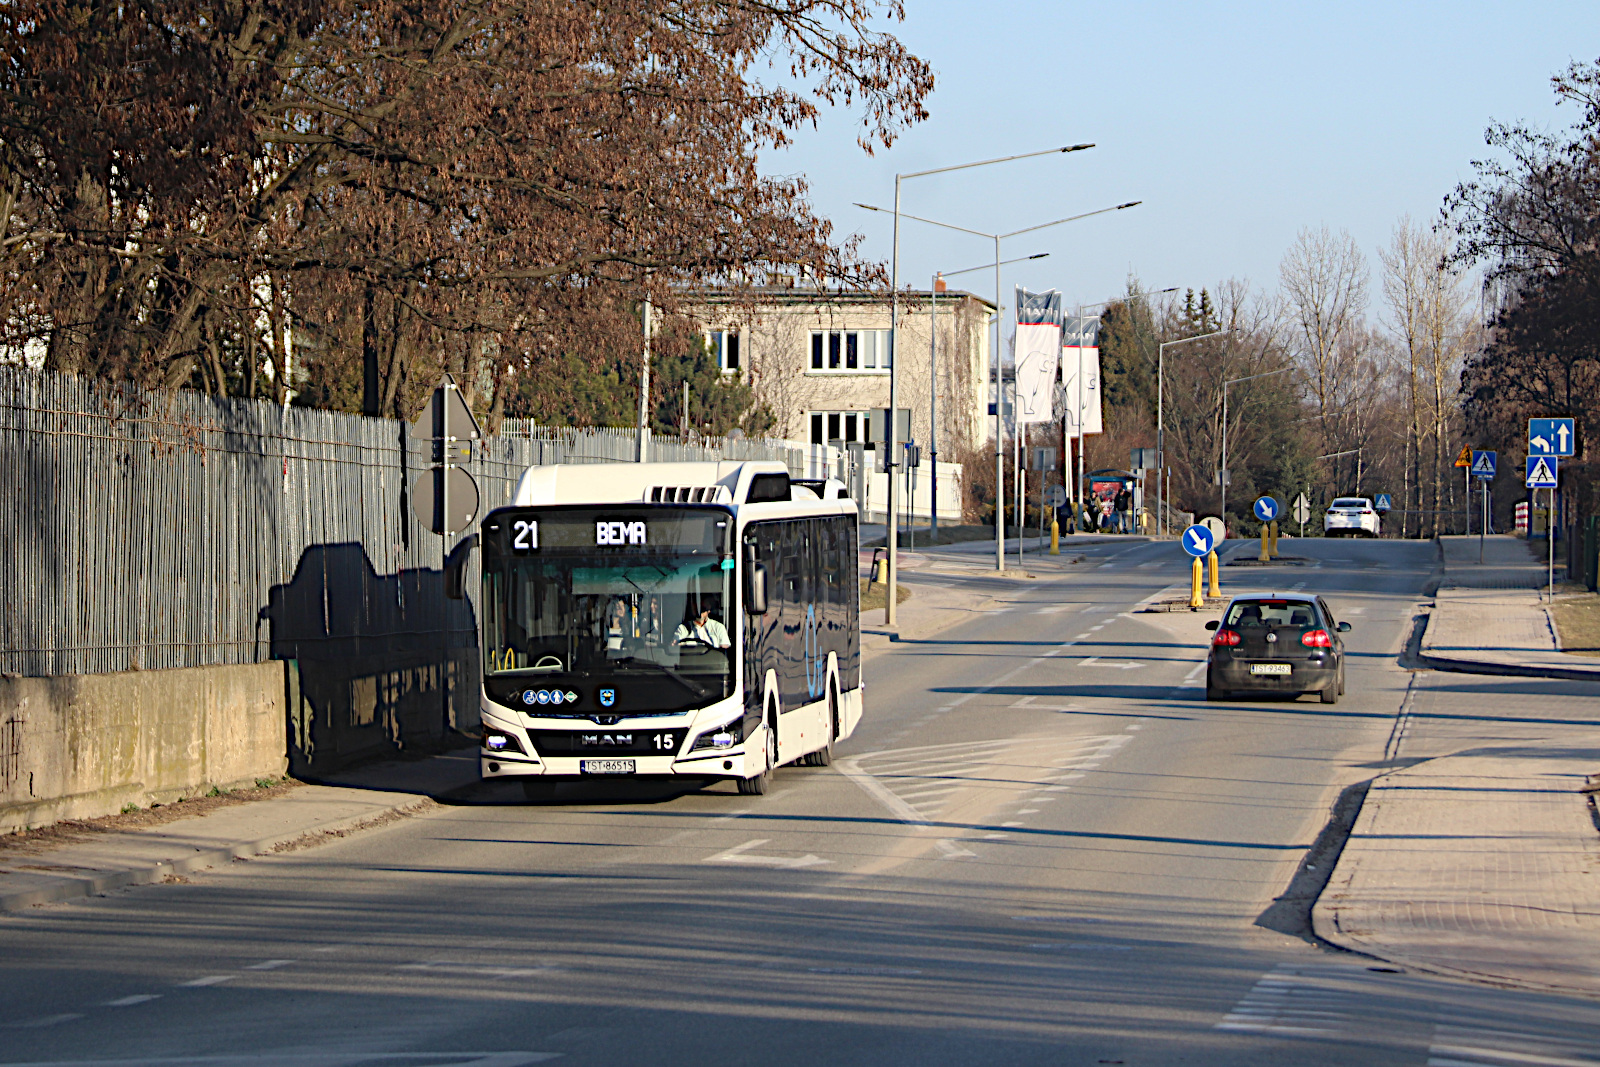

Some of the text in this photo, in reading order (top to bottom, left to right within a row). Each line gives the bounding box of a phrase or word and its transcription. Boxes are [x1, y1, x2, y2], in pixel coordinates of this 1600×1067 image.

[513, 520, 538, 549] 21
[596, 521, 646, 545] BEMA
[581, 734, 633, 745] MAN
[653, 733, 674, 750] 15
